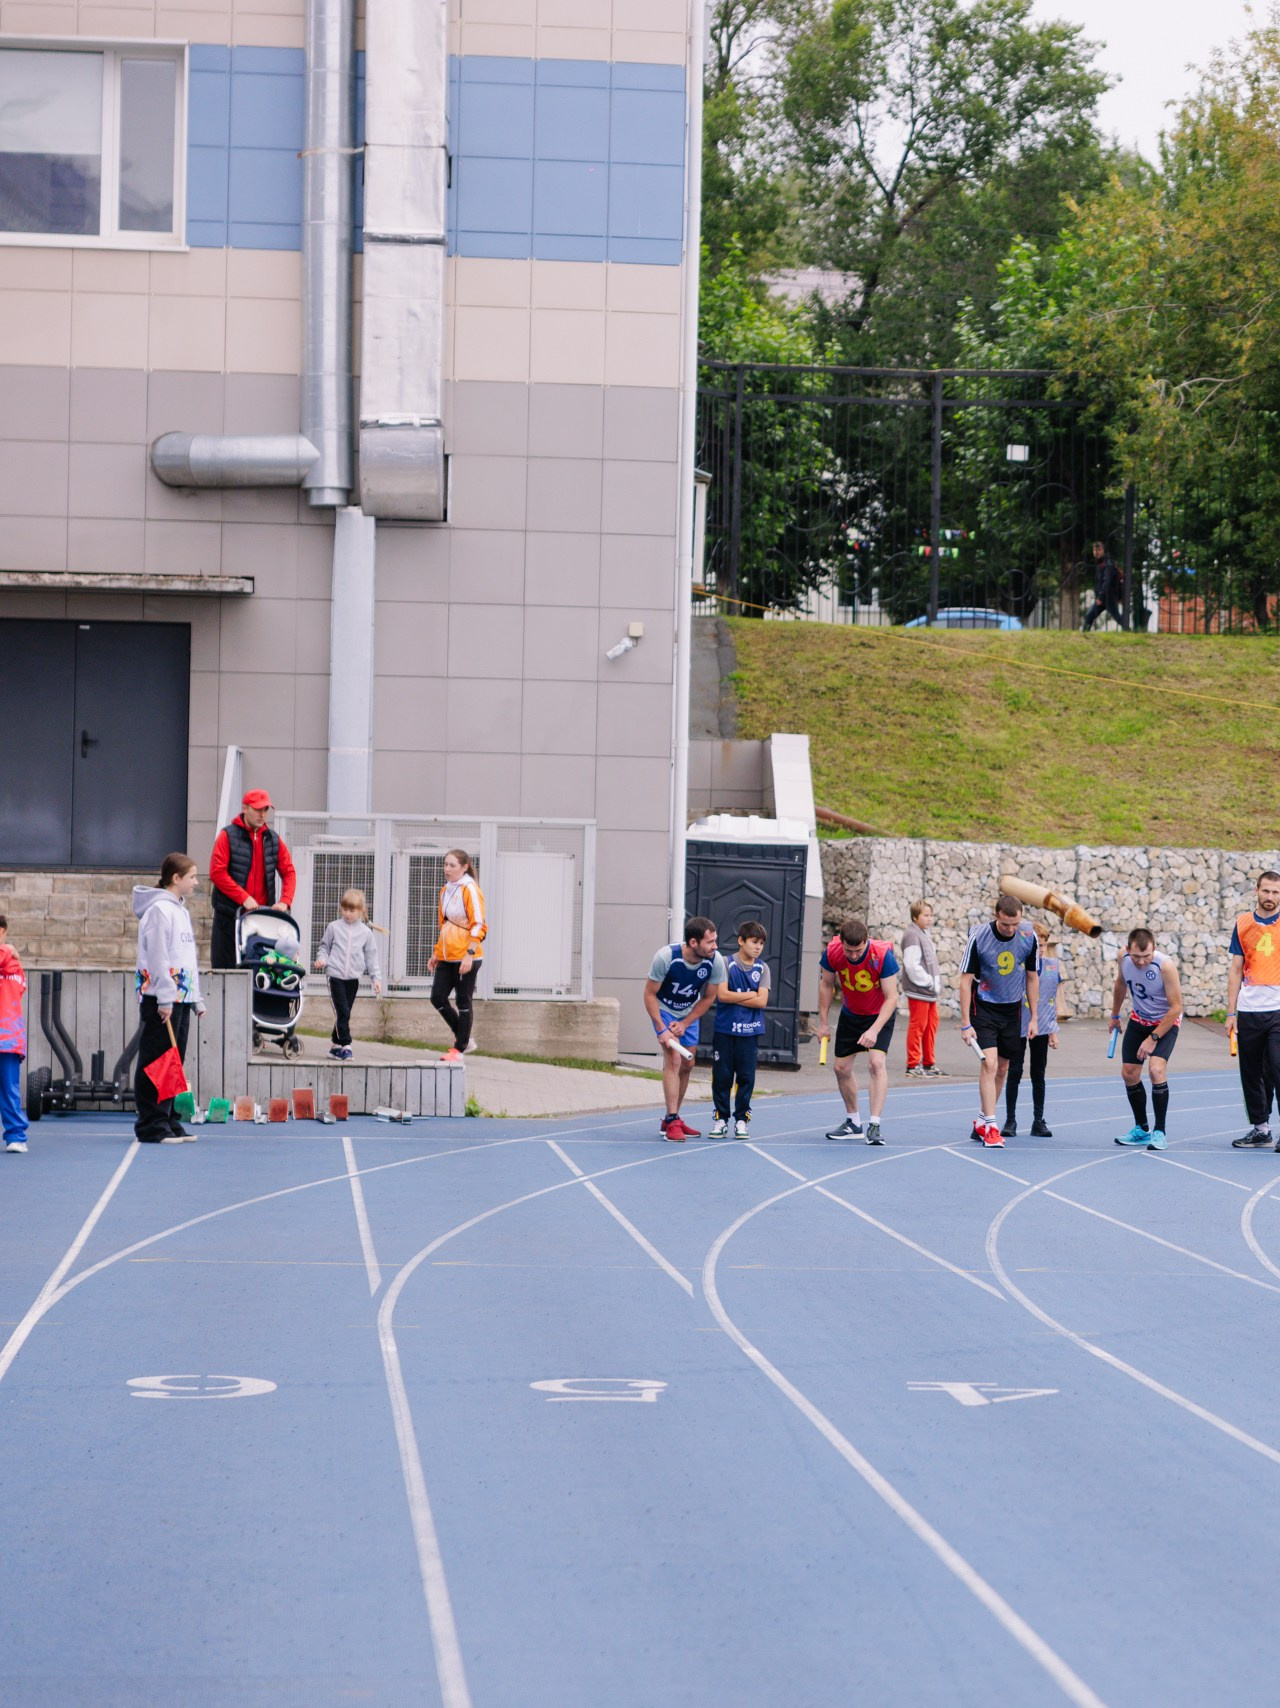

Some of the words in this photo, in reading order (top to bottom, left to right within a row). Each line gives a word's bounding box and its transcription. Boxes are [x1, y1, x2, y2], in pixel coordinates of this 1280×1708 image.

[1256, 932, 1275, 957] 4
[997, 951, 1015, 976] 9
[671, 982, 694, 998] 14
[840, 967, 874, 993] 18
[1126, 979, 1148, 1000] 13
[126, 1374, 278, 1399] 6
[529, 1378, 669, 1402] 5
[906, 1381, 1060, 1406] 4
